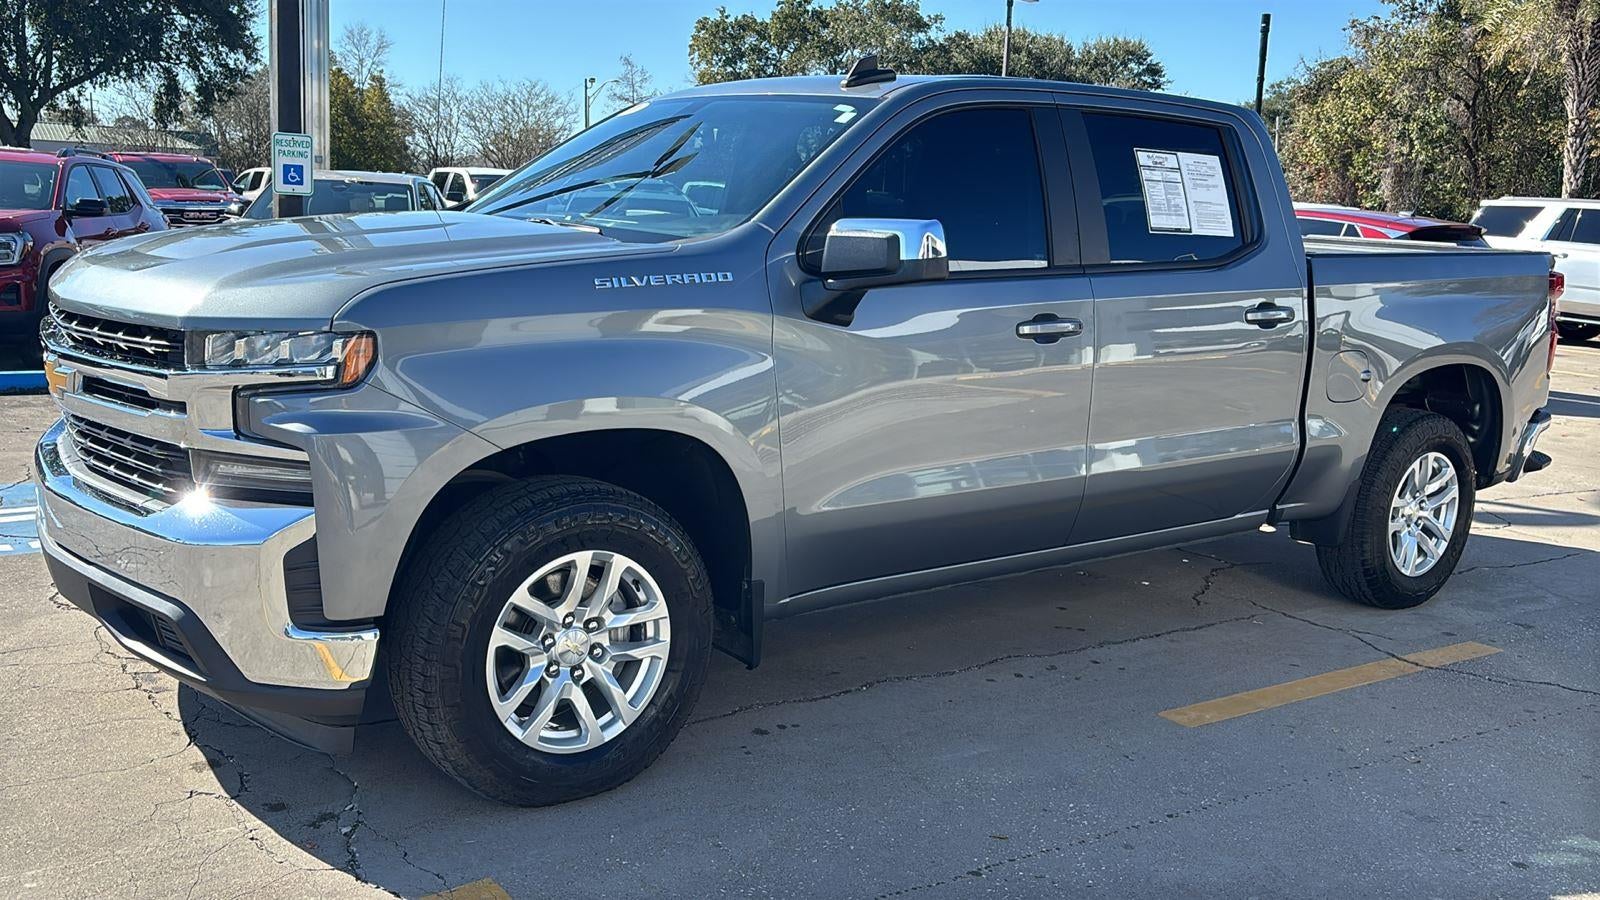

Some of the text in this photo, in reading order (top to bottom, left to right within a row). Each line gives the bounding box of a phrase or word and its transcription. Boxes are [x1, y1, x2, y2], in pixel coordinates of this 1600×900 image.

[275, 139, 311, 149] RESERVED
[278, 149, 309, 159] PARKING
[183, 211, 217, 219] GMC
[594, 271, 734, 289] SILVERADO
